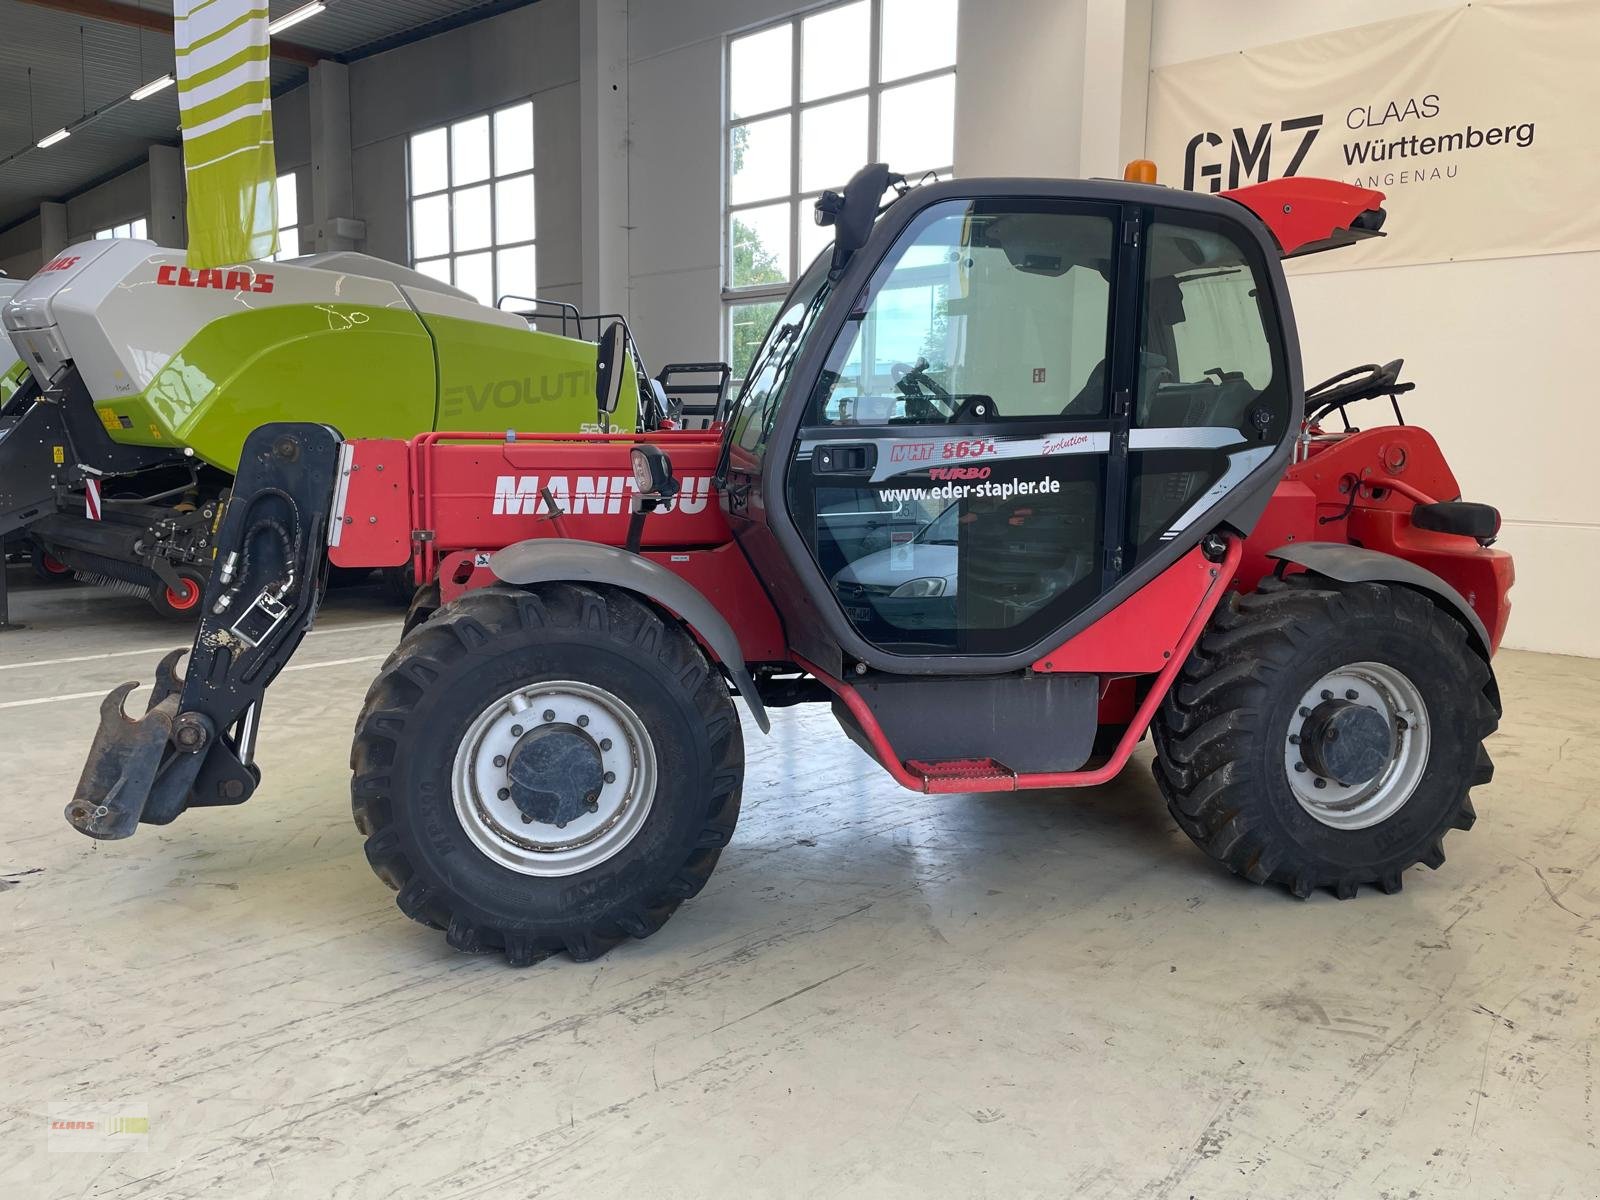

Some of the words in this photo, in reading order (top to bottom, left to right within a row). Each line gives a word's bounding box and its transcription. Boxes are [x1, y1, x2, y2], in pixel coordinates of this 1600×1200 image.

[1345, 94, 1440, 130] CLAAS
[1343, 122, 1535, 166] Württemberg
[1342, 165, 1458, 188] ANGENAU
[156, 265, 275, 293] CLAAS
[444, 369, 597, 418] EVOLUTI
[889, 443, 934, 462] MHT
[1042, 434, 1089, 456] Evolution
[929, 467, 991, 480] TURBO
[879, 476, 1060, 503] www.eder-stapler.de
